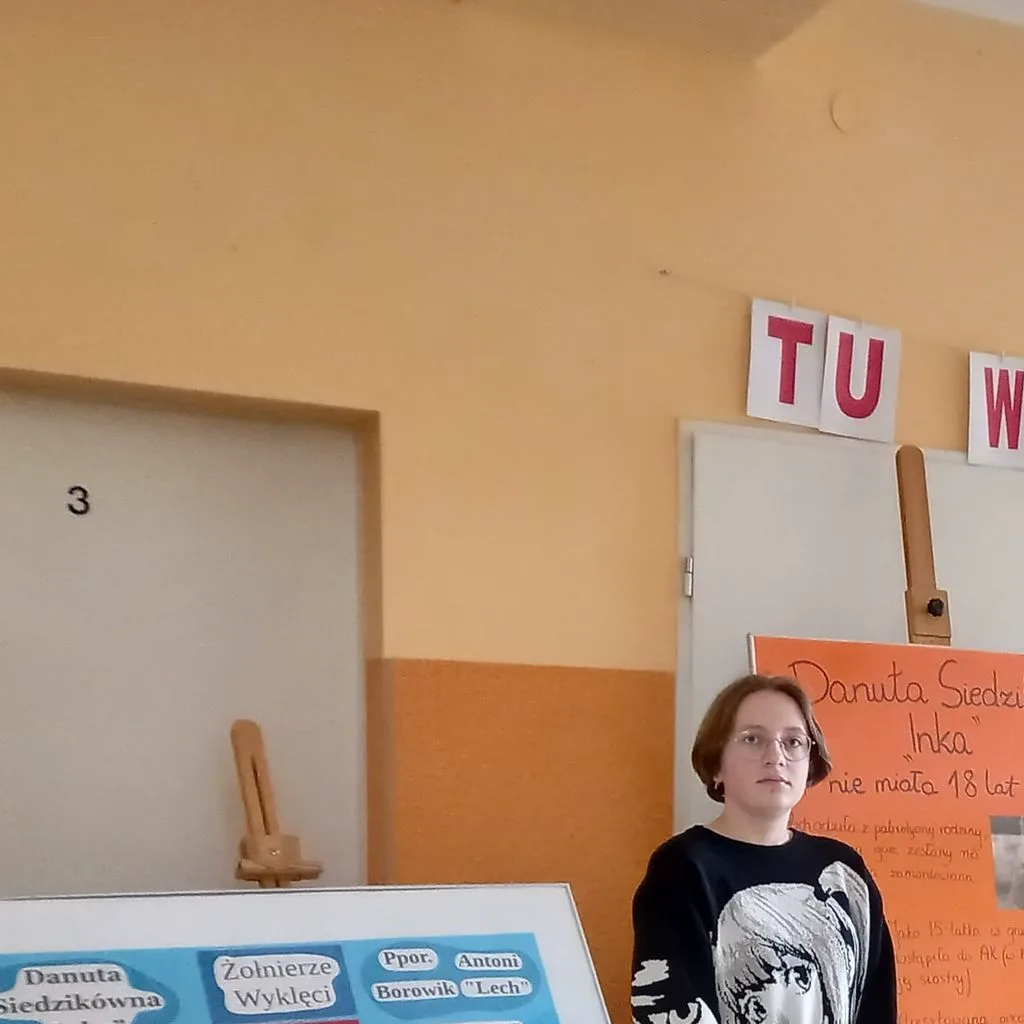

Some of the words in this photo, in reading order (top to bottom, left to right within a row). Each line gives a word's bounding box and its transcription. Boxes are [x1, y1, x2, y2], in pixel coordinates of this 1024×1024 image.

[767, 315, 885, 419] TU
[67, 485, 90, 515] 3
[788, 659, 930, 705] Danuta
[828, 772, 866, 794] nie
[875, 770, 939, 796] miała
[948, 770, 978, 799] 18
[986, 769, 1020, 798] lat
[223, 959, 333, 982] Żołnierze
[384, 951, 433, 968] Ppor.
[458, 954, 520, 968] Antoni
[24, 968, 121, 985] Danuta
[234, 985, 332, 1011] Wyklęci
[376, 982, 456, 1000] Borowik
